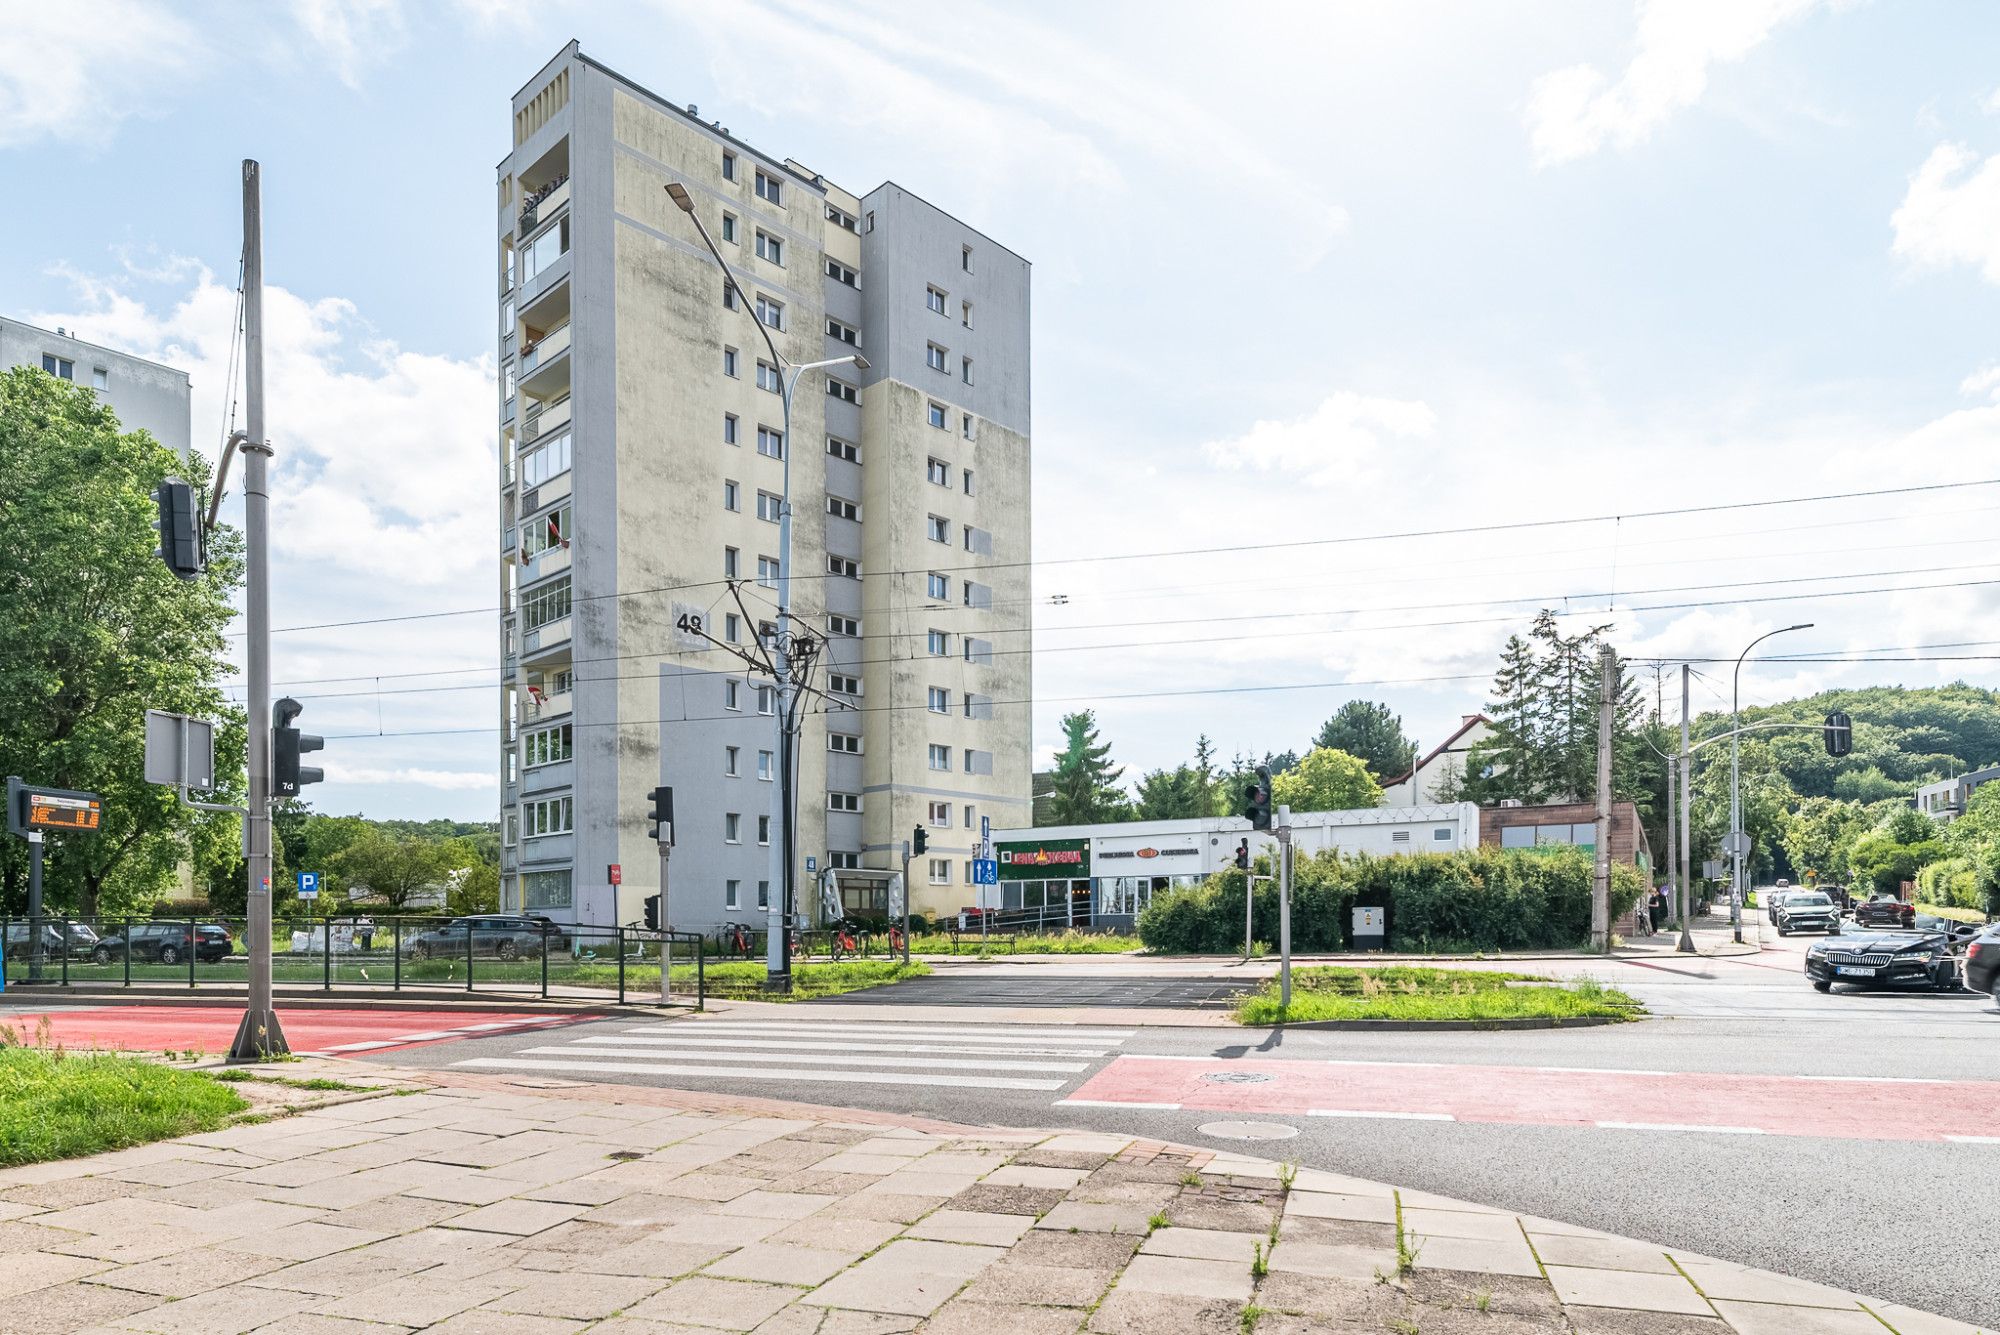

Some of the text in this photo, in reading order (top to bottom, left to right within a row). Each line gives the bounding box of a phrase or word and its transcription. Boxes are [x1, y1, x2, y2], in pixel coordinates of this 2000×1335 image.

[677, 613, 702, 635] 48
[282, 782, 294, 790] 7d
[302, 874, 314, 890] P
